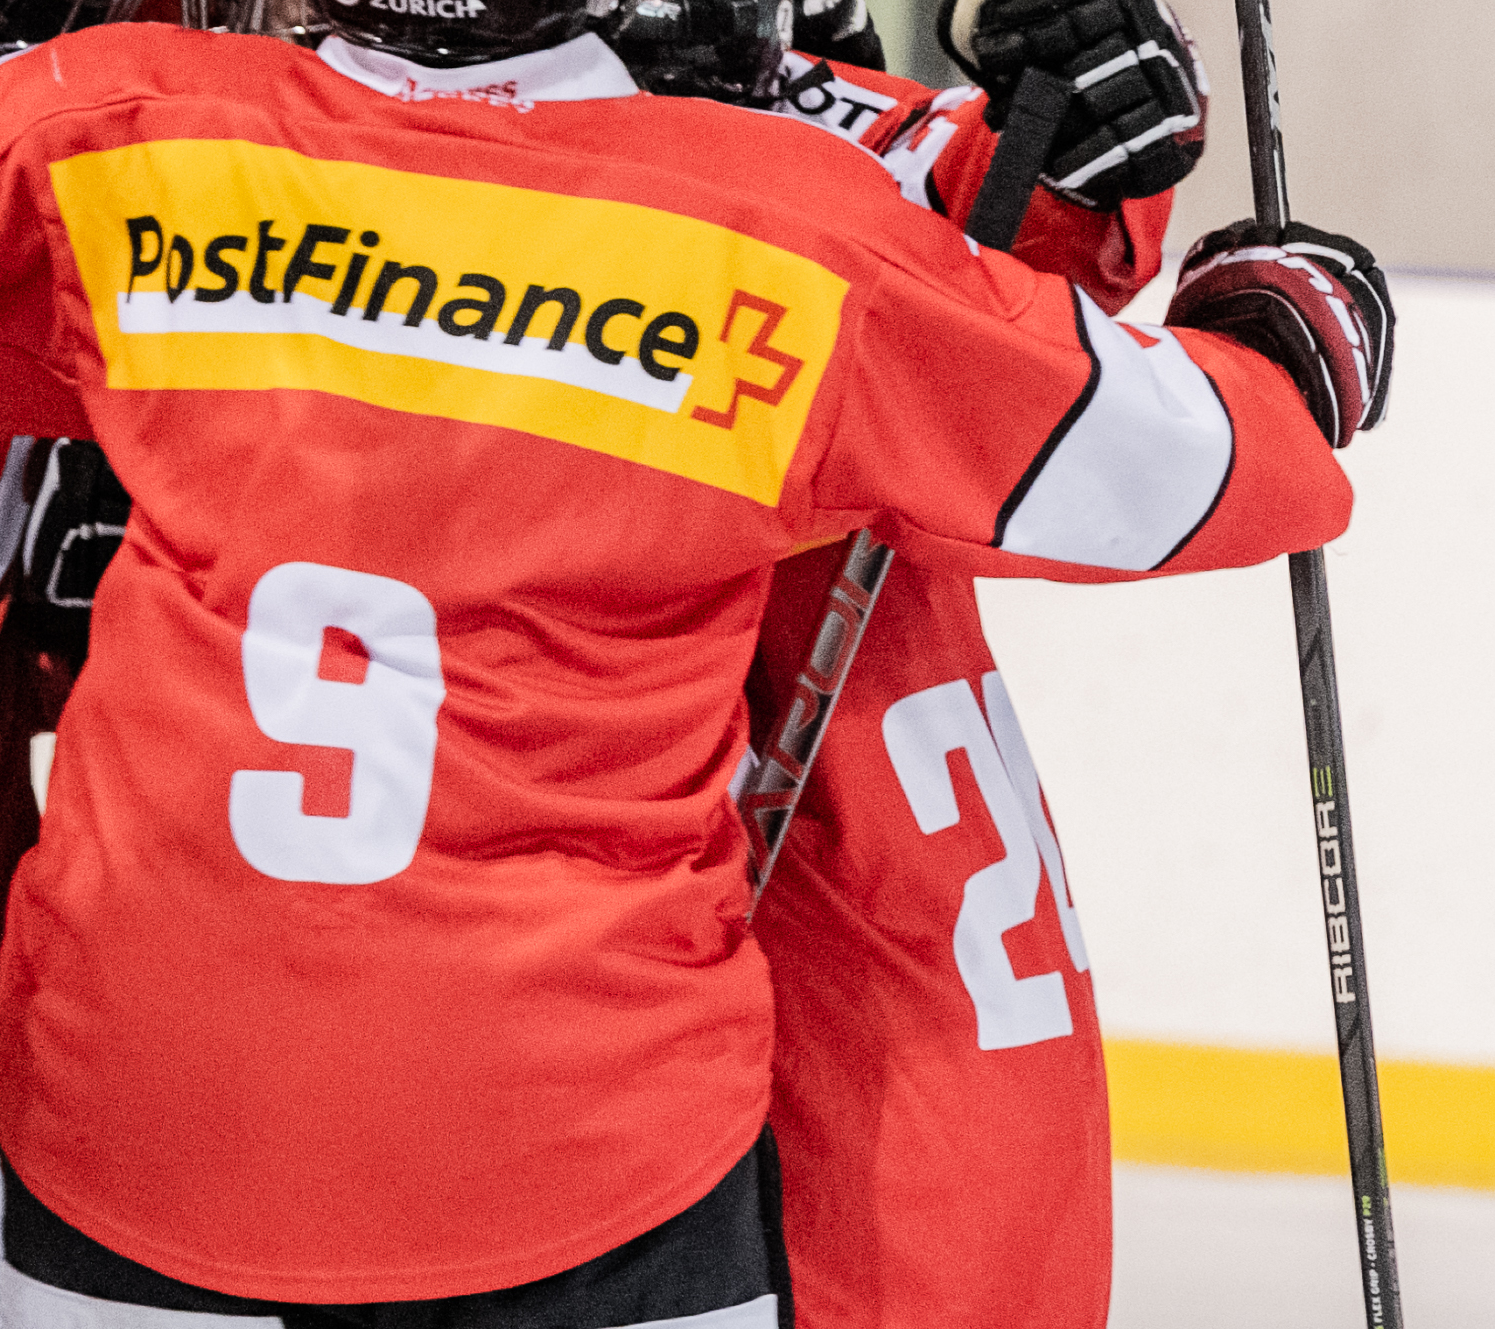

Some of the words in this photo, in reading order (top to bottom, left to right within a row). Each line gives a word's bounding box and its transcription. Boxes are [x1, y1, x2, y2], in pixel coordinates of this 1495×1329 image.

[125, 215, 702, 383] PostFinance
[228, 560, 447, 886] 9
[1311, 766, 1356, 1005] RIBCORE
